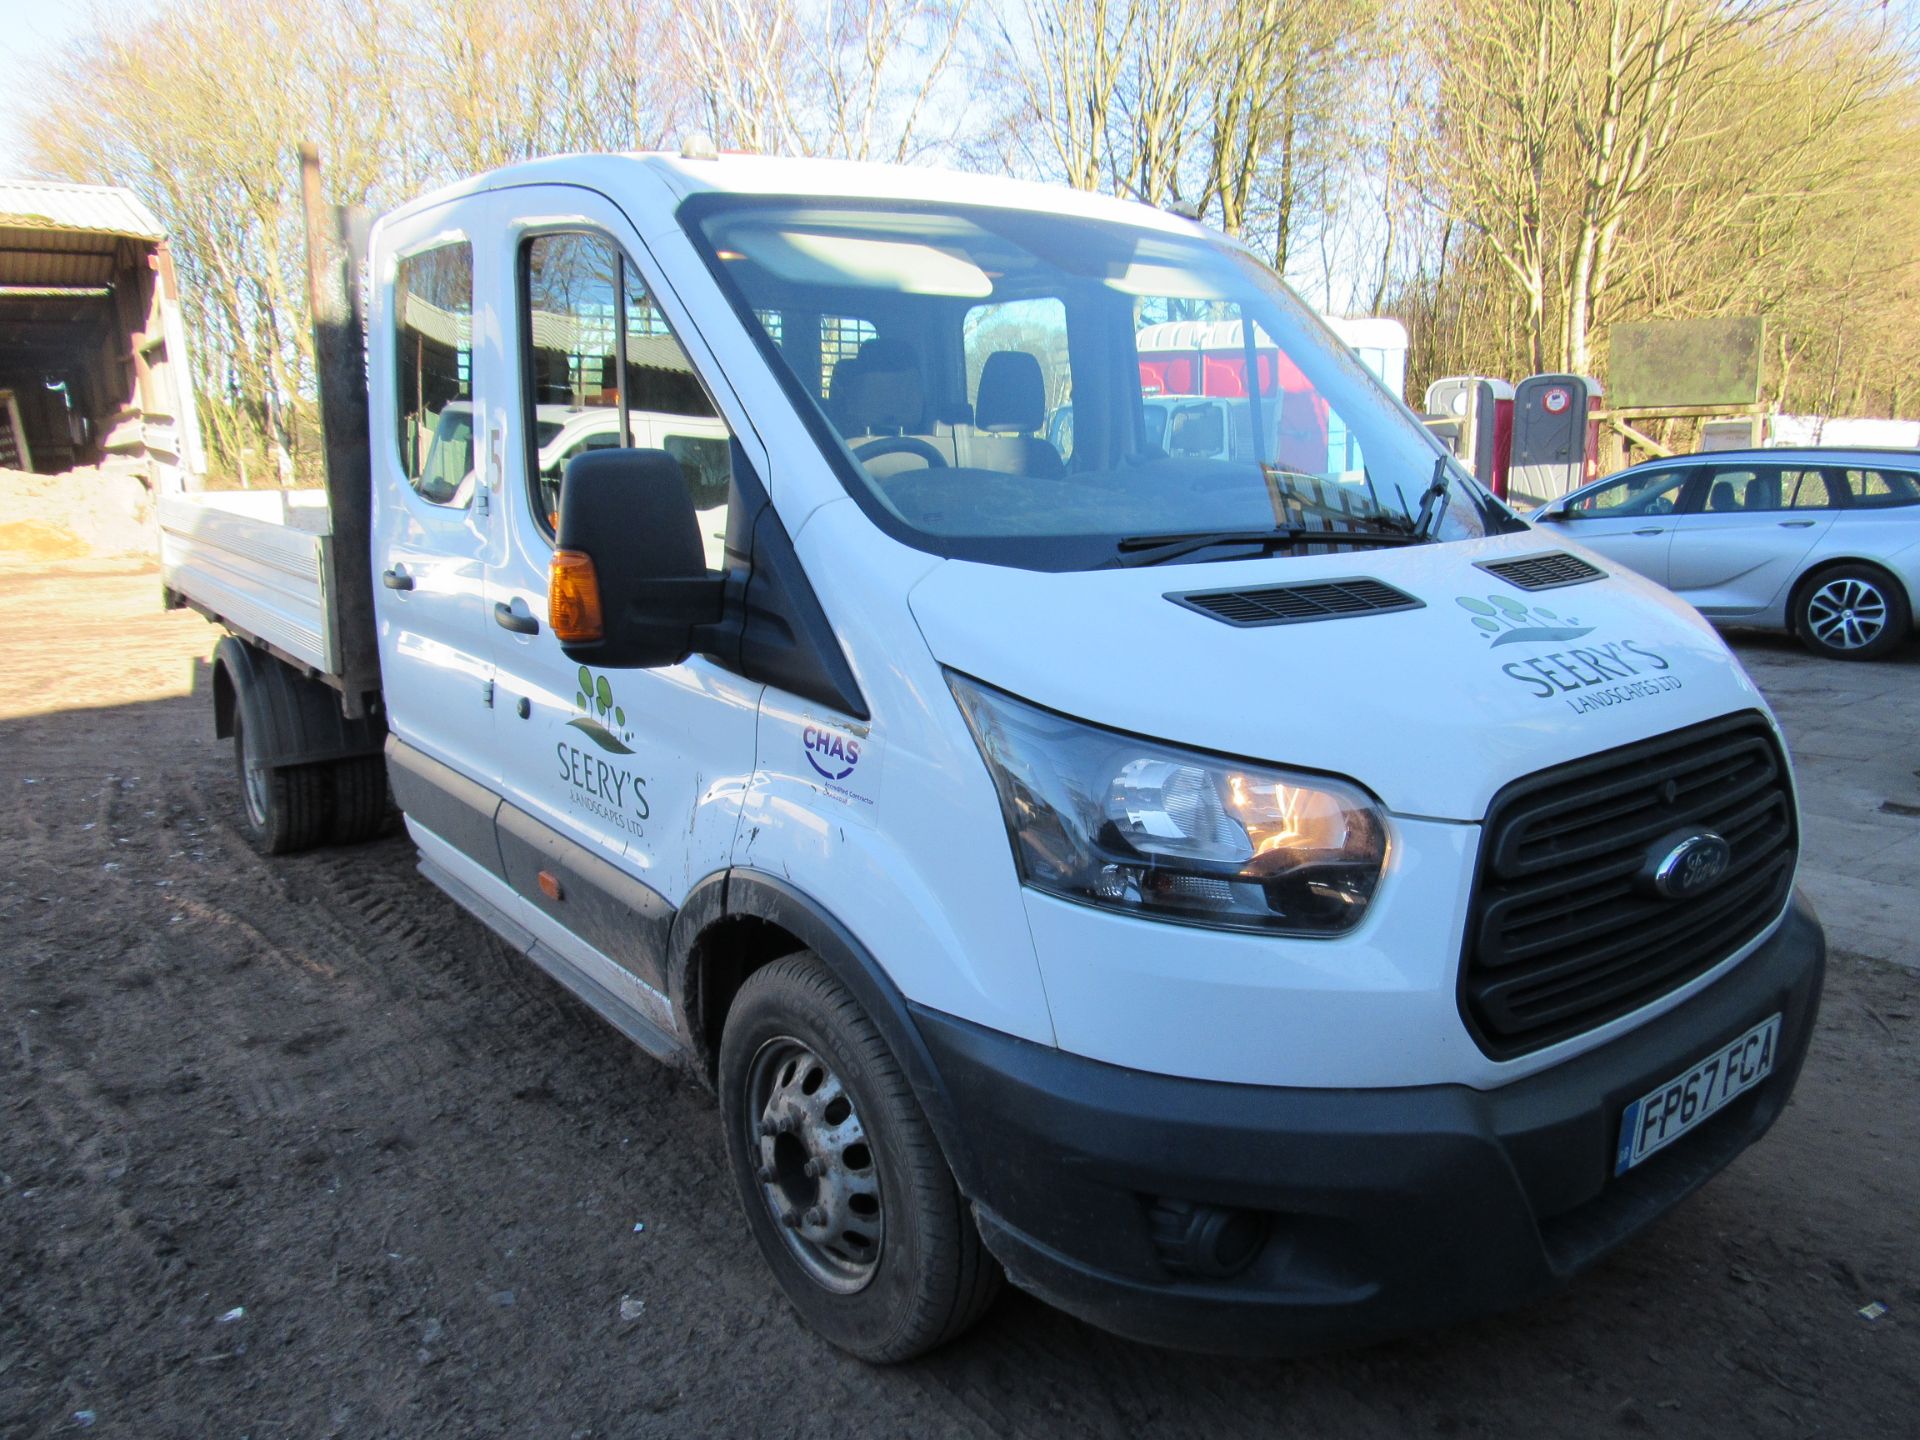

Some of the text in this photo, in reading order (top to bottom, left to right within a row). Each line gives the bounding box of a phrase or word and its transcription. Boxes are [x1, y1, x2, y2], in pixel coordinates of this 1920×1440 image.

[1501, 639, 1669, 698] SEERY'S
[1566, 675, 1682, 714] LANDSCAPES LTD
[803, 725, 859, 765] CHAS
[557, 741, 649, 820] SEERY'S
[569, 789, 644, 838] LANDSCAPES LTD
[1638, 1025, 1773, 1153] FP67 FCA
